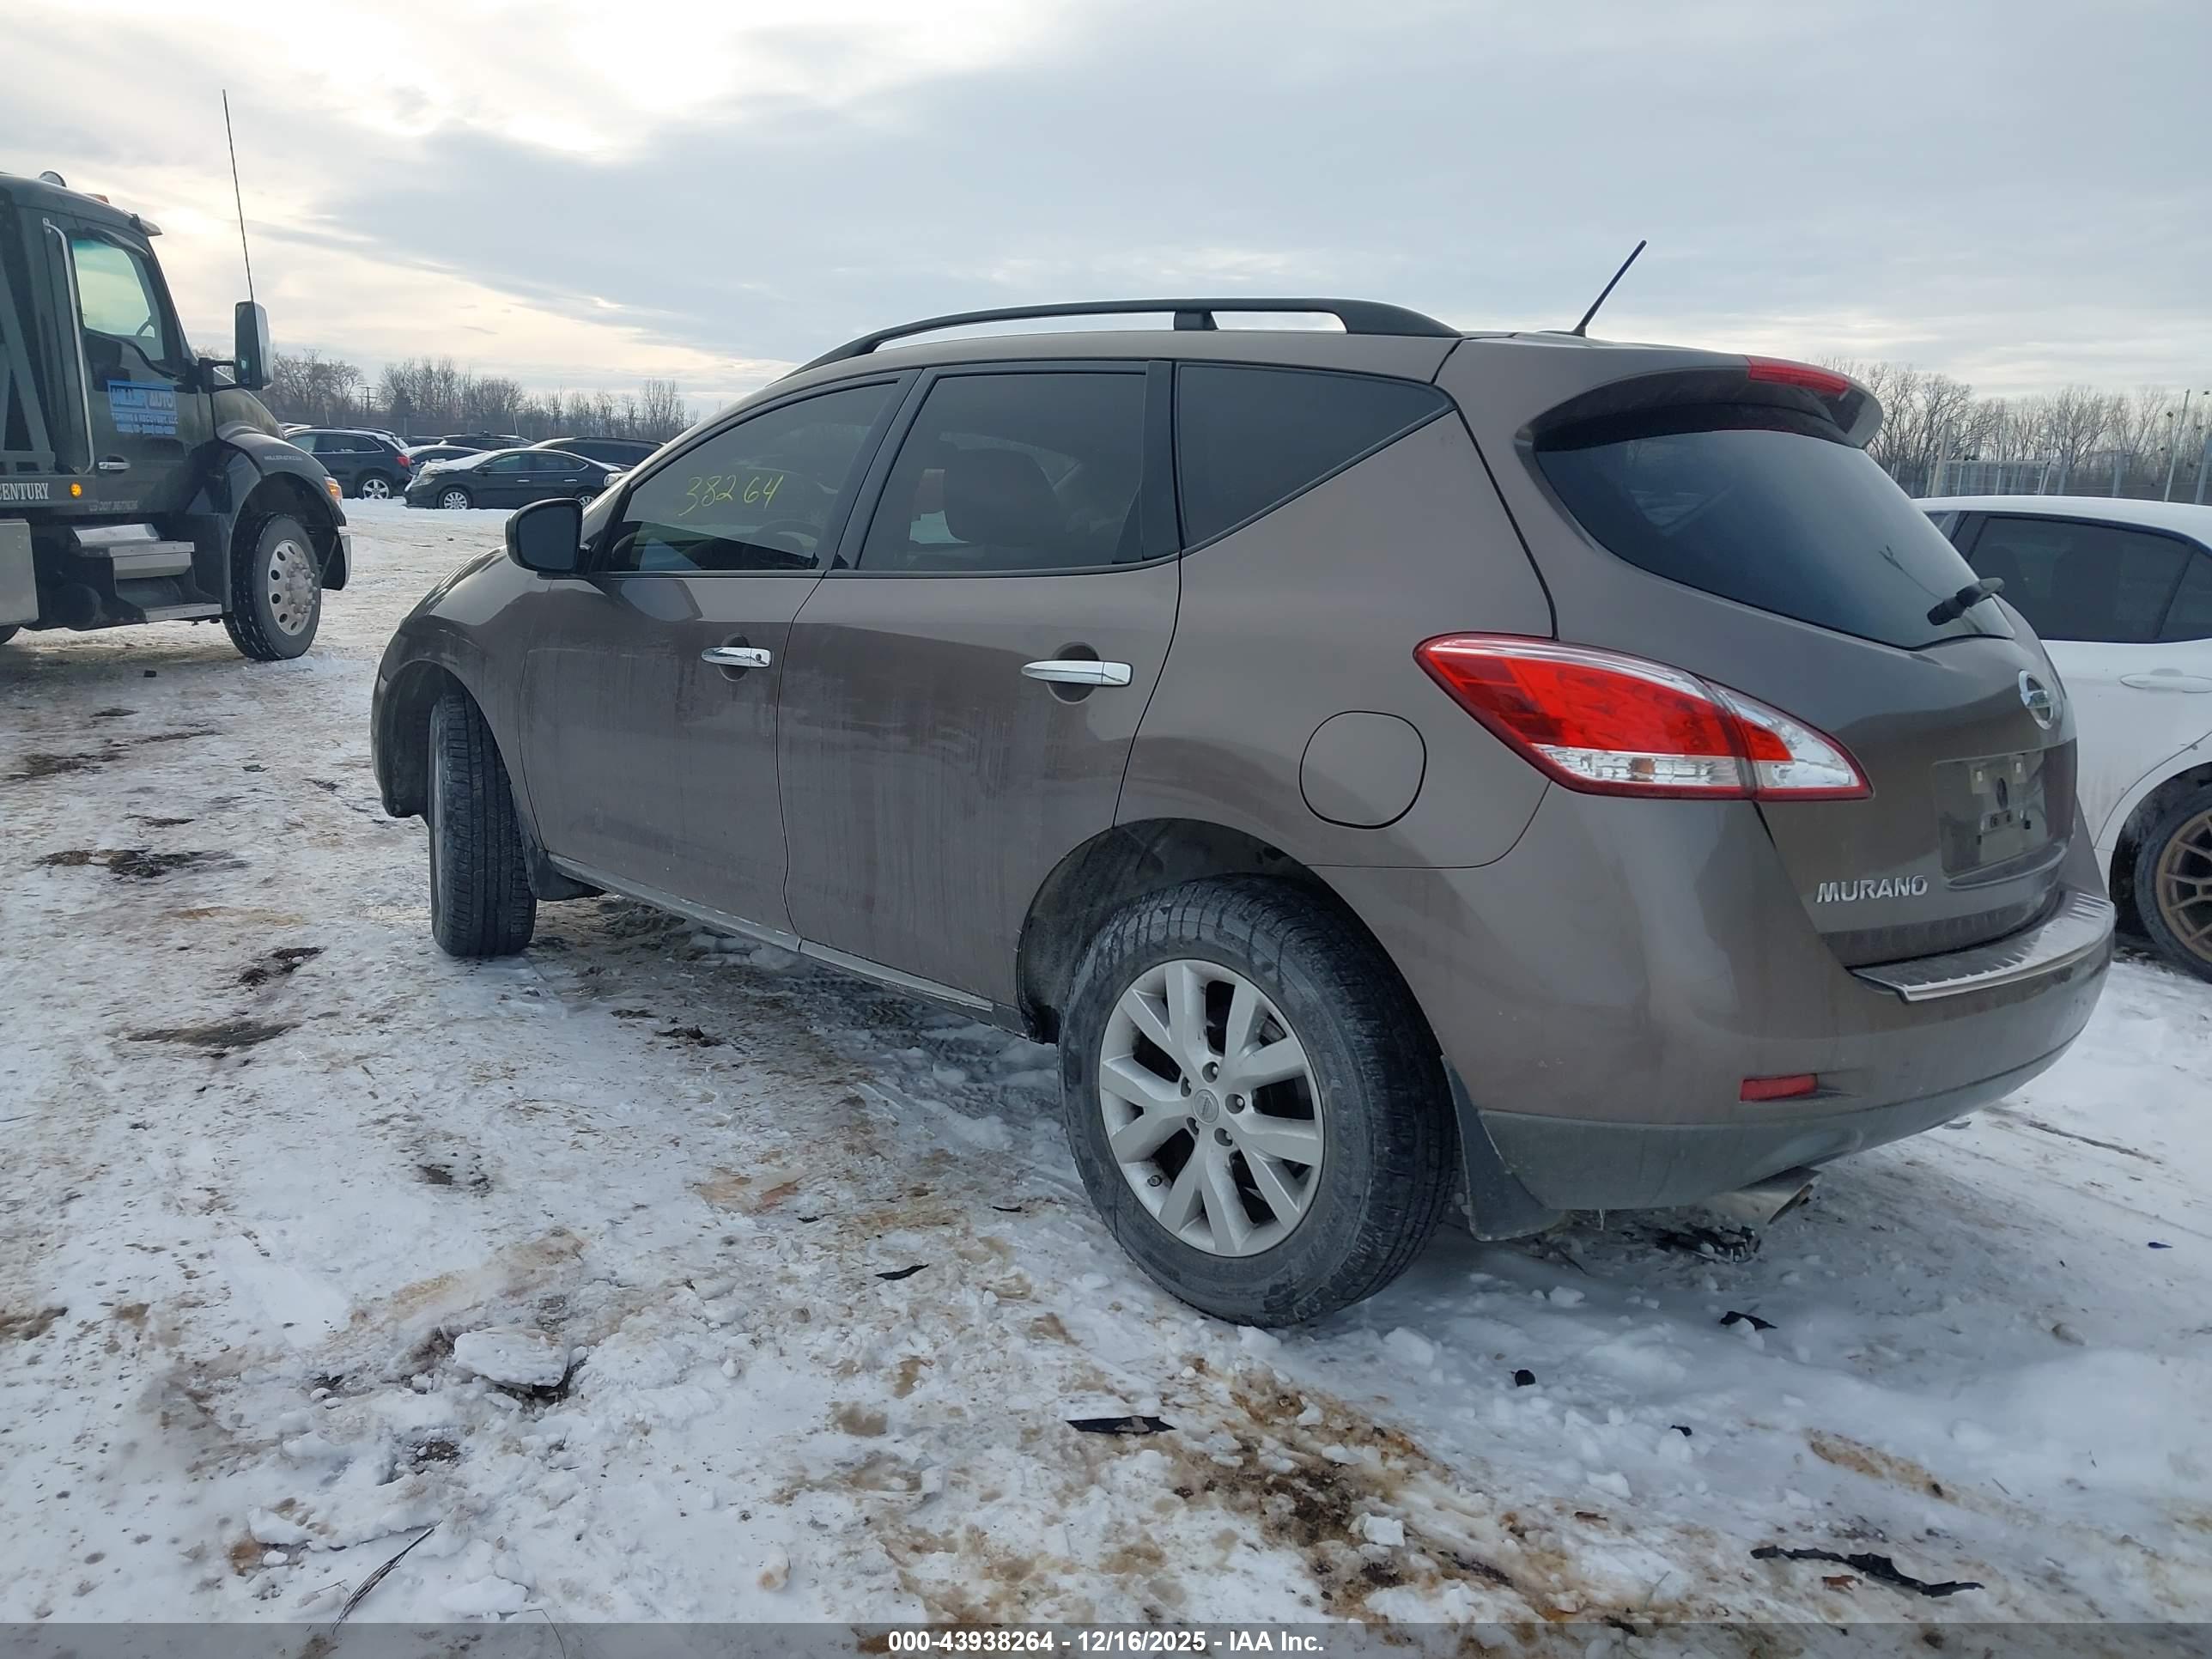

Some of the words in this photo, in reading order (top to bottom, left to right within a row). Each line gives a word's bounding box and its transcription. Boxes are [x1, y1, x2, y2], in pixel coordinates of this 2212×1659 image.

[149, 390, 174, 409] AUTO
[0, 483, 49, 500] ENTURY
[1816, 874, 1929, 903] MURANO
